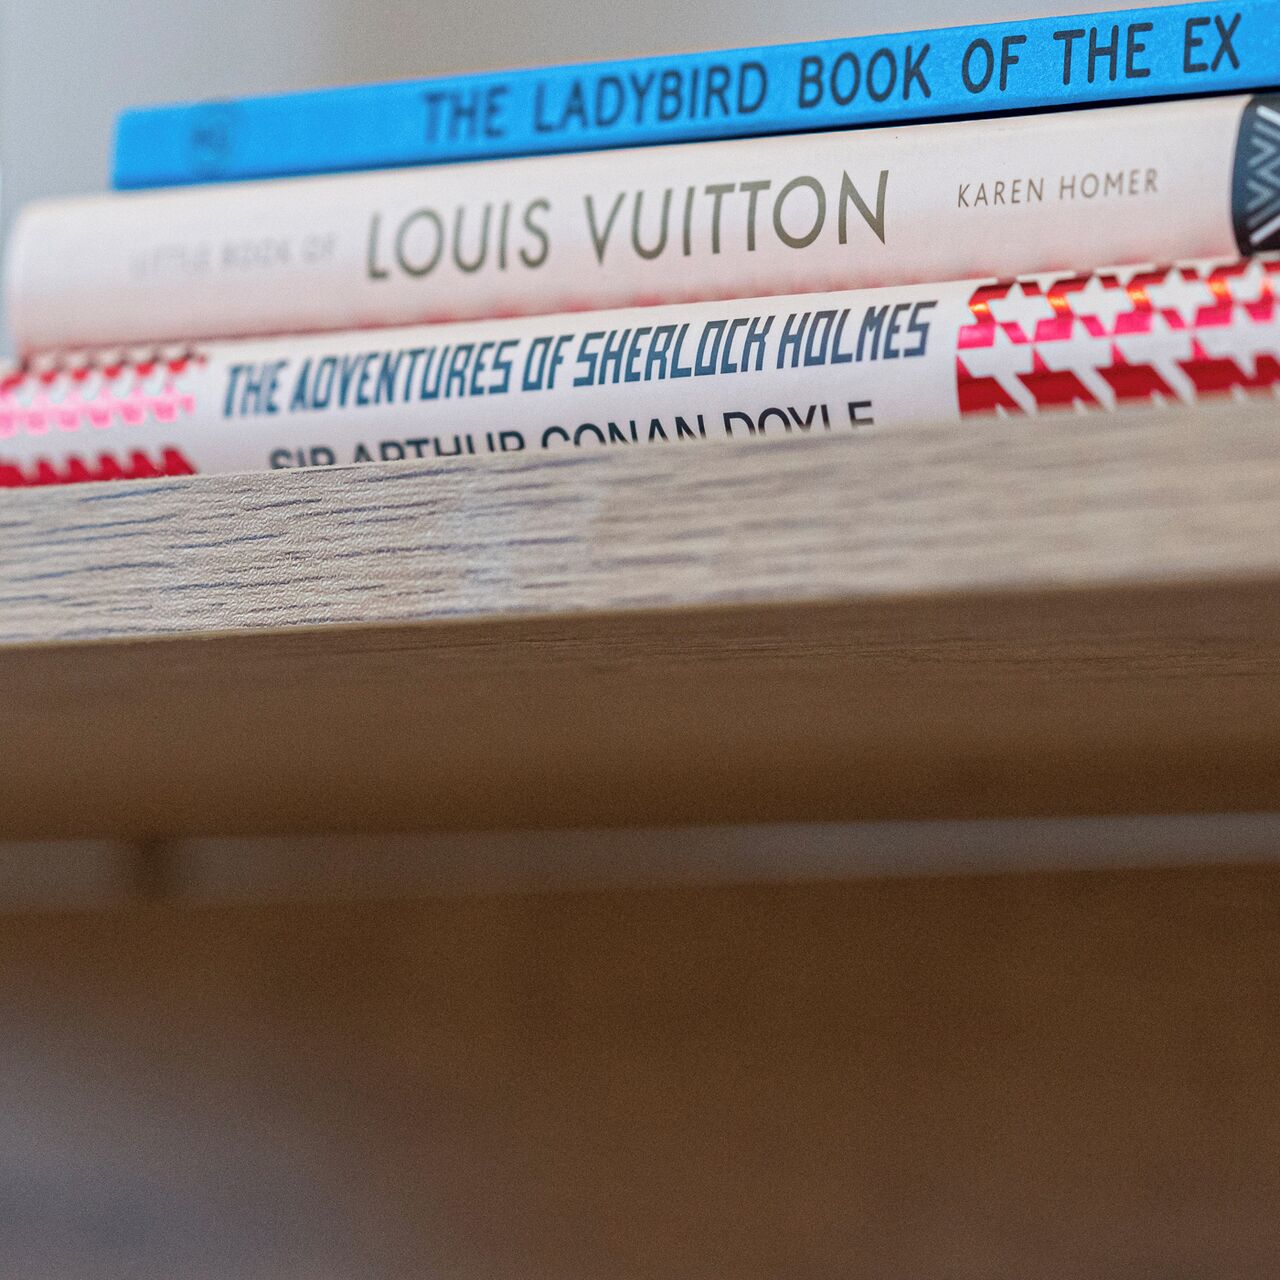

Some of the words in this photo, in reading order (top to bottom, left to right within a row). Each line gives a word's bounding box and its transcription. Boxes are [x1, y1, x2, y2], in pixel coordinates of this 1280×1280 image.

[422, 84, 511, 143] THE
[532, 62, 768, 134] LADYBIRD
[798, 42, 932, 109] BOOK
[961, 34, 1028, 94] OF
[1053, 22, 1154, 86] THE
[1183, 12, 1242, 74] EX
[366, 197, 551, 279] LOUIS
[584, 169, 890, 266] VUITTON
[957, 177, 1045, 208] KAREN
[1059, 168, 1159, 200] HOMER
[223, 359, 289, 420] THE
[289, 339, 520, 414] ADVENTURES
[522, 334, 575, 392] OF
[572, 315, 776, 388] SHERLOCK
[776, 300, 939, 369] HOLMES
